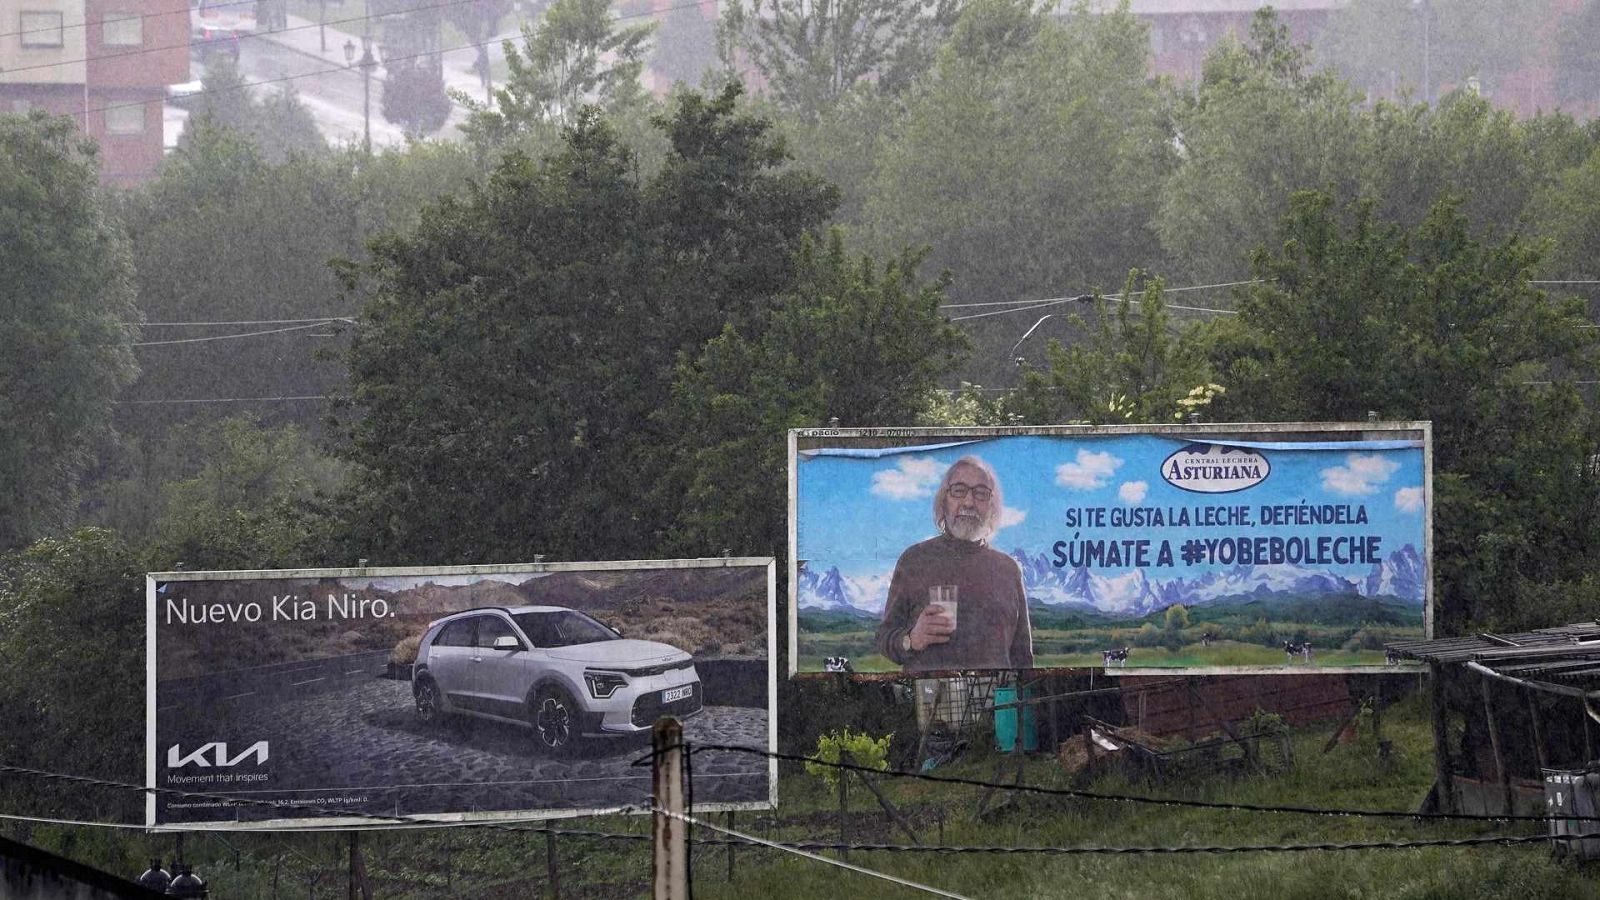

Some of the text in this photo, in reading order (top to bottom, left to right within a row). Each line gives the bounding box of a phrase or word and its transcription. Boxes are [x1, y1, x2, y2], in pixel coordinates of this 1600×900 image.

[1066, 498, 1369, 528] SI TE GUSTA LA LECHE, DEFIÉNDELA
[1052, 531, 1382, 568] SÚMATE A #YOBEBOLECHE
[166, 593, 396, 625] Nuevo Kia Niro.
[167, 773, 269, 784] Movement that inspires
